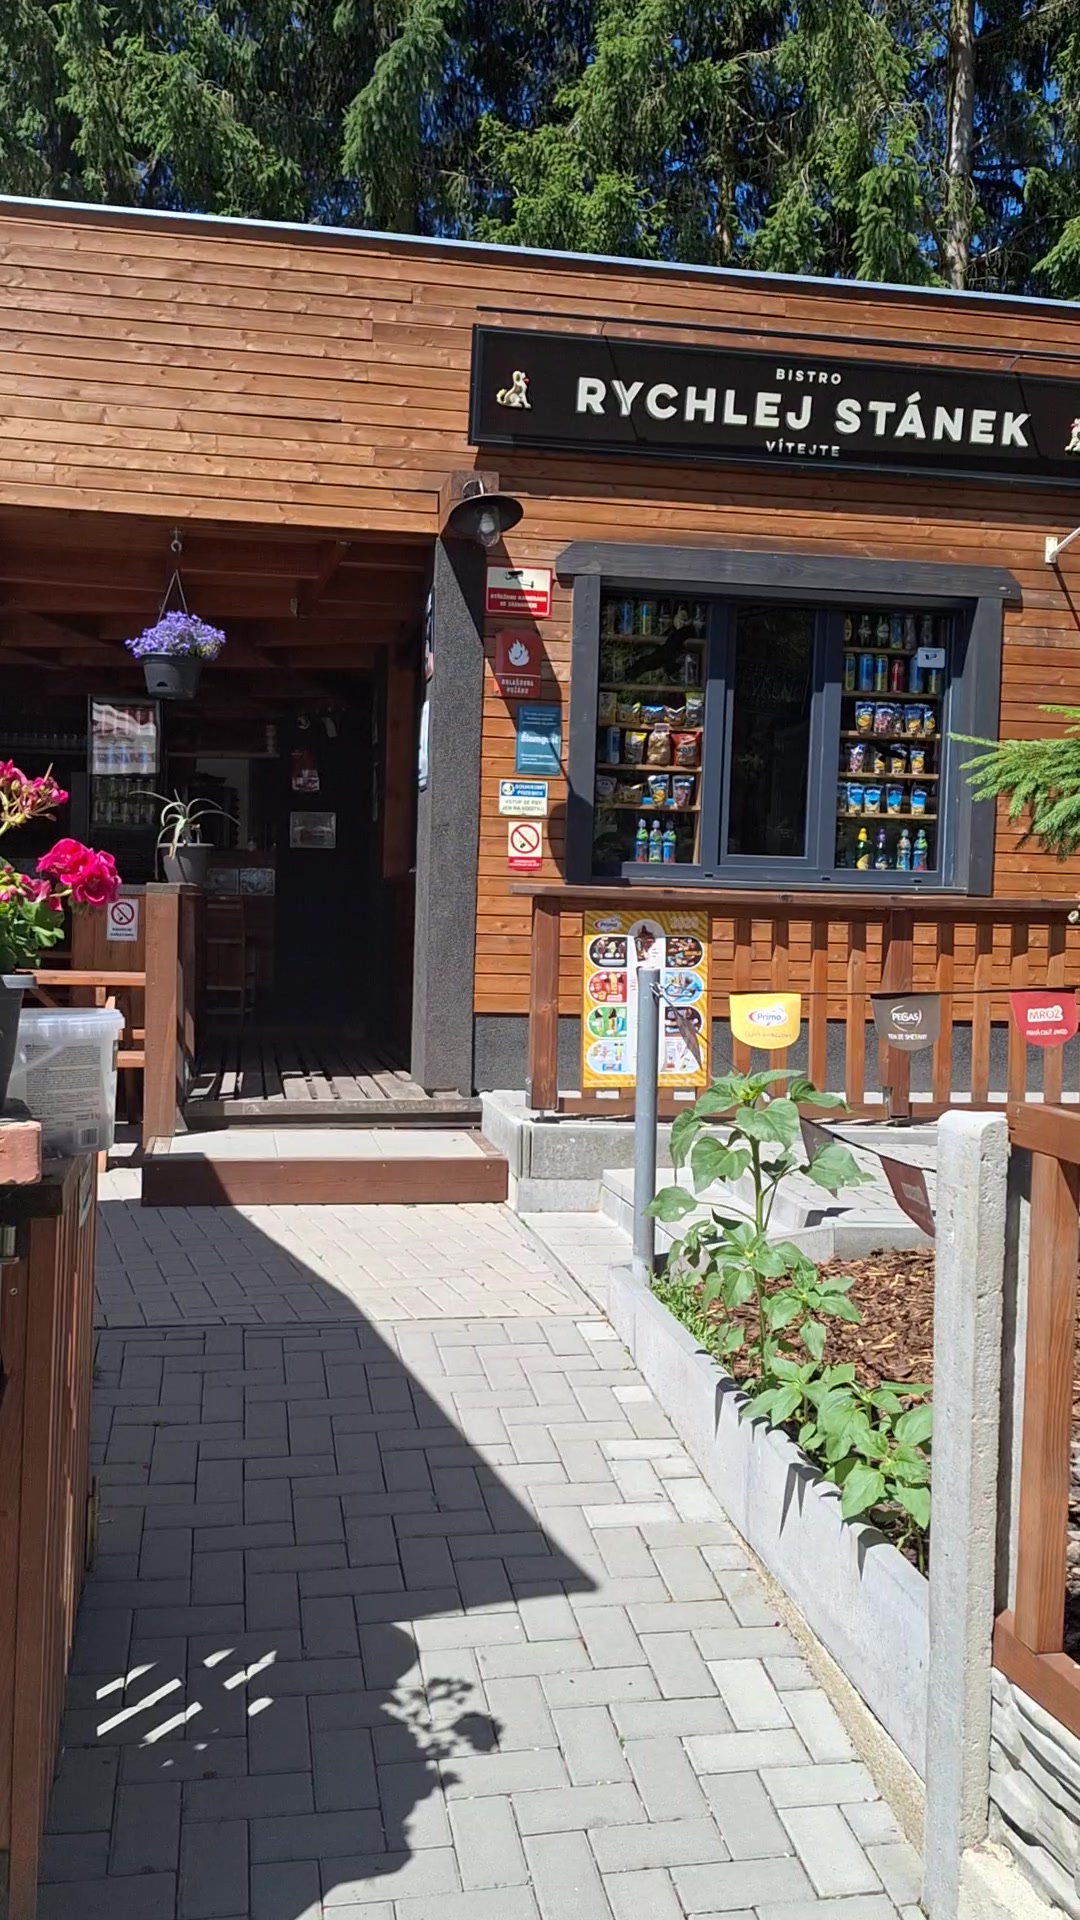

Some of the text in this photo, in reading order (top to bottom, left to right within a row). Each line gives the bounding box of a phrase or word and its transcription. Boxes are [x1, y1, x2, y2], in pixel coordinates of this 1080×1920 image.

[775, 368, 842, 386] BISTRO
[575, 376, 1030, 448] RYCHLEJ STÁNEK
[765, 439, 840, 458] VÍTEJTE
[757, 1012, 782, 1021] Primo
[891, 1012, 919, 1022] PEGAS
